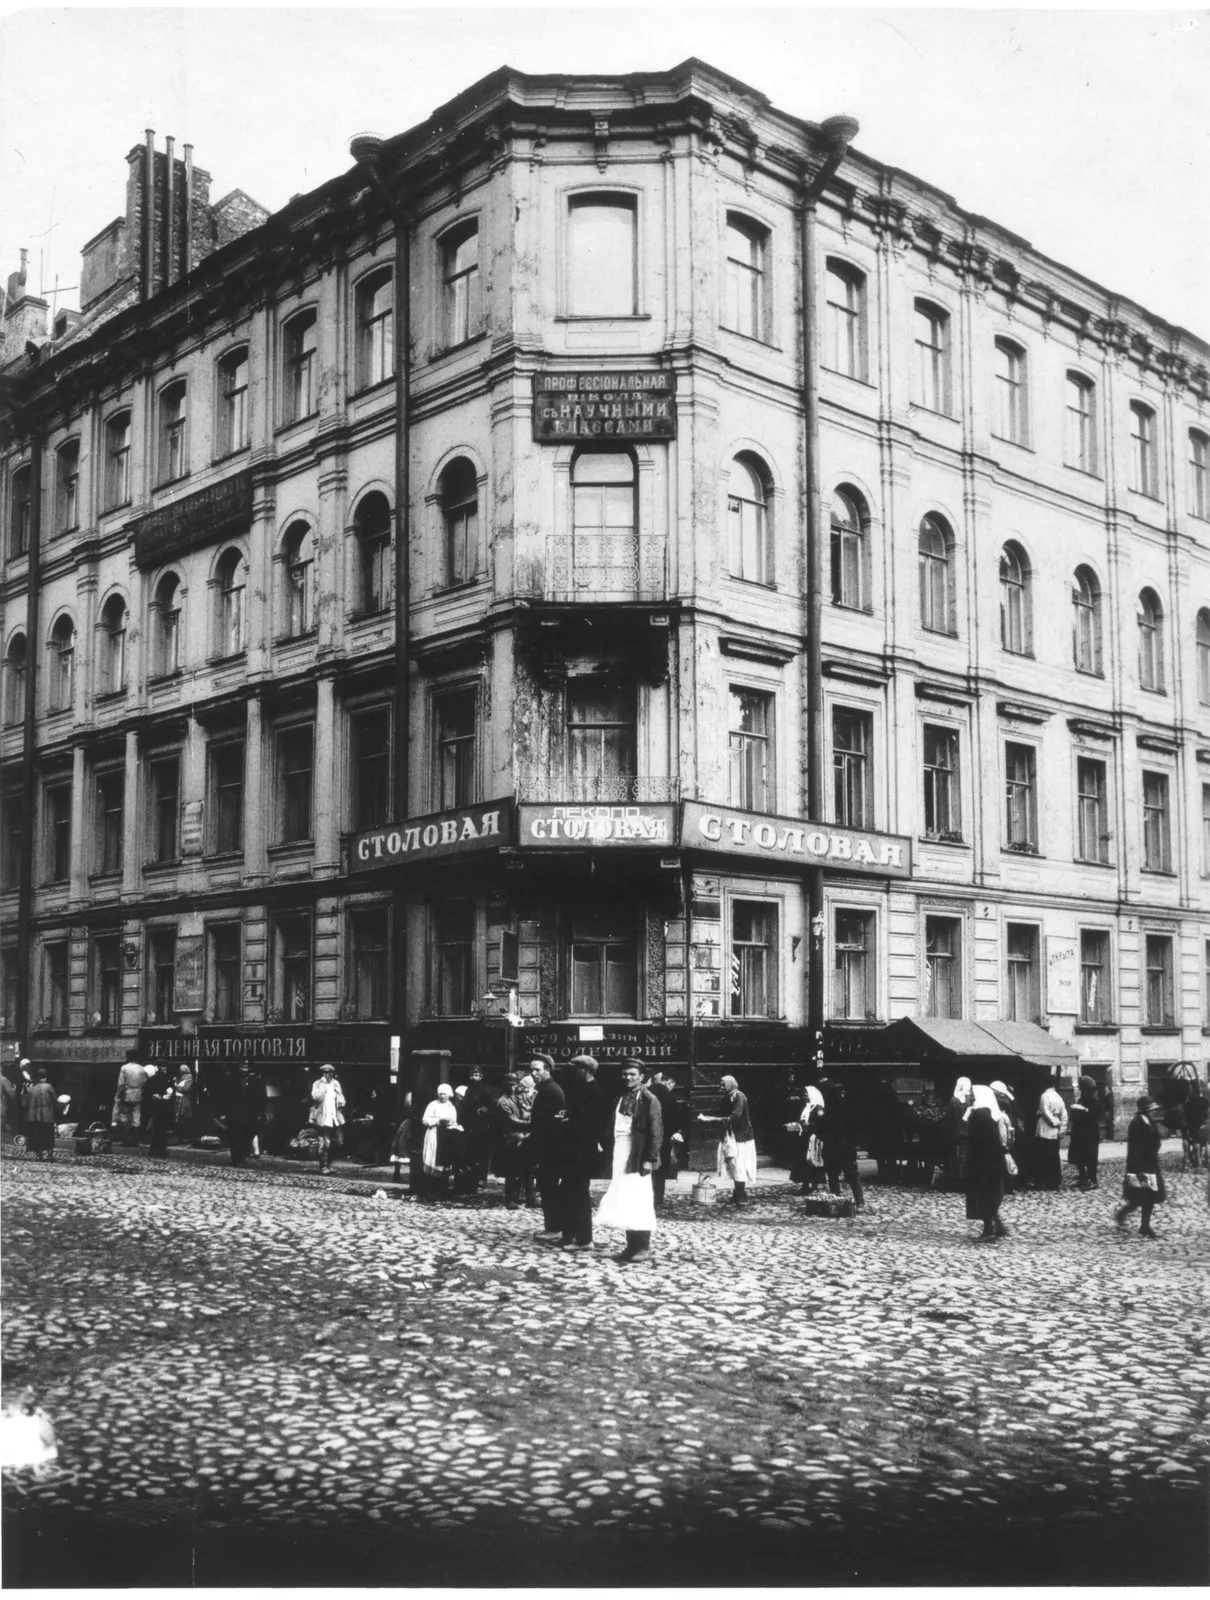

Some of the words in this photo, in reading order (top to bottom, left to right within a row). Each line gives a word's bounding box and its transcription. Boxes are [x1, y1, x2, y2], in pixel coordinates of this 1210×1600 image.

[560, 403, 667, 418] НАУЧНЫМИ
[555, 419, 653, 434] КЛАССАМИ
[358, 811, 500, 860] СТОЛОВАЯ
[531, 818, 667, 839] СТОЛОВАЯ
[699, 814, 903, 867] СТОЛОВАЯ
[148, 1039, 220, 1057] ЗЕЛЕННАЯ
[223, 1038, 306, 1057] ТОРГОВЛЯ
